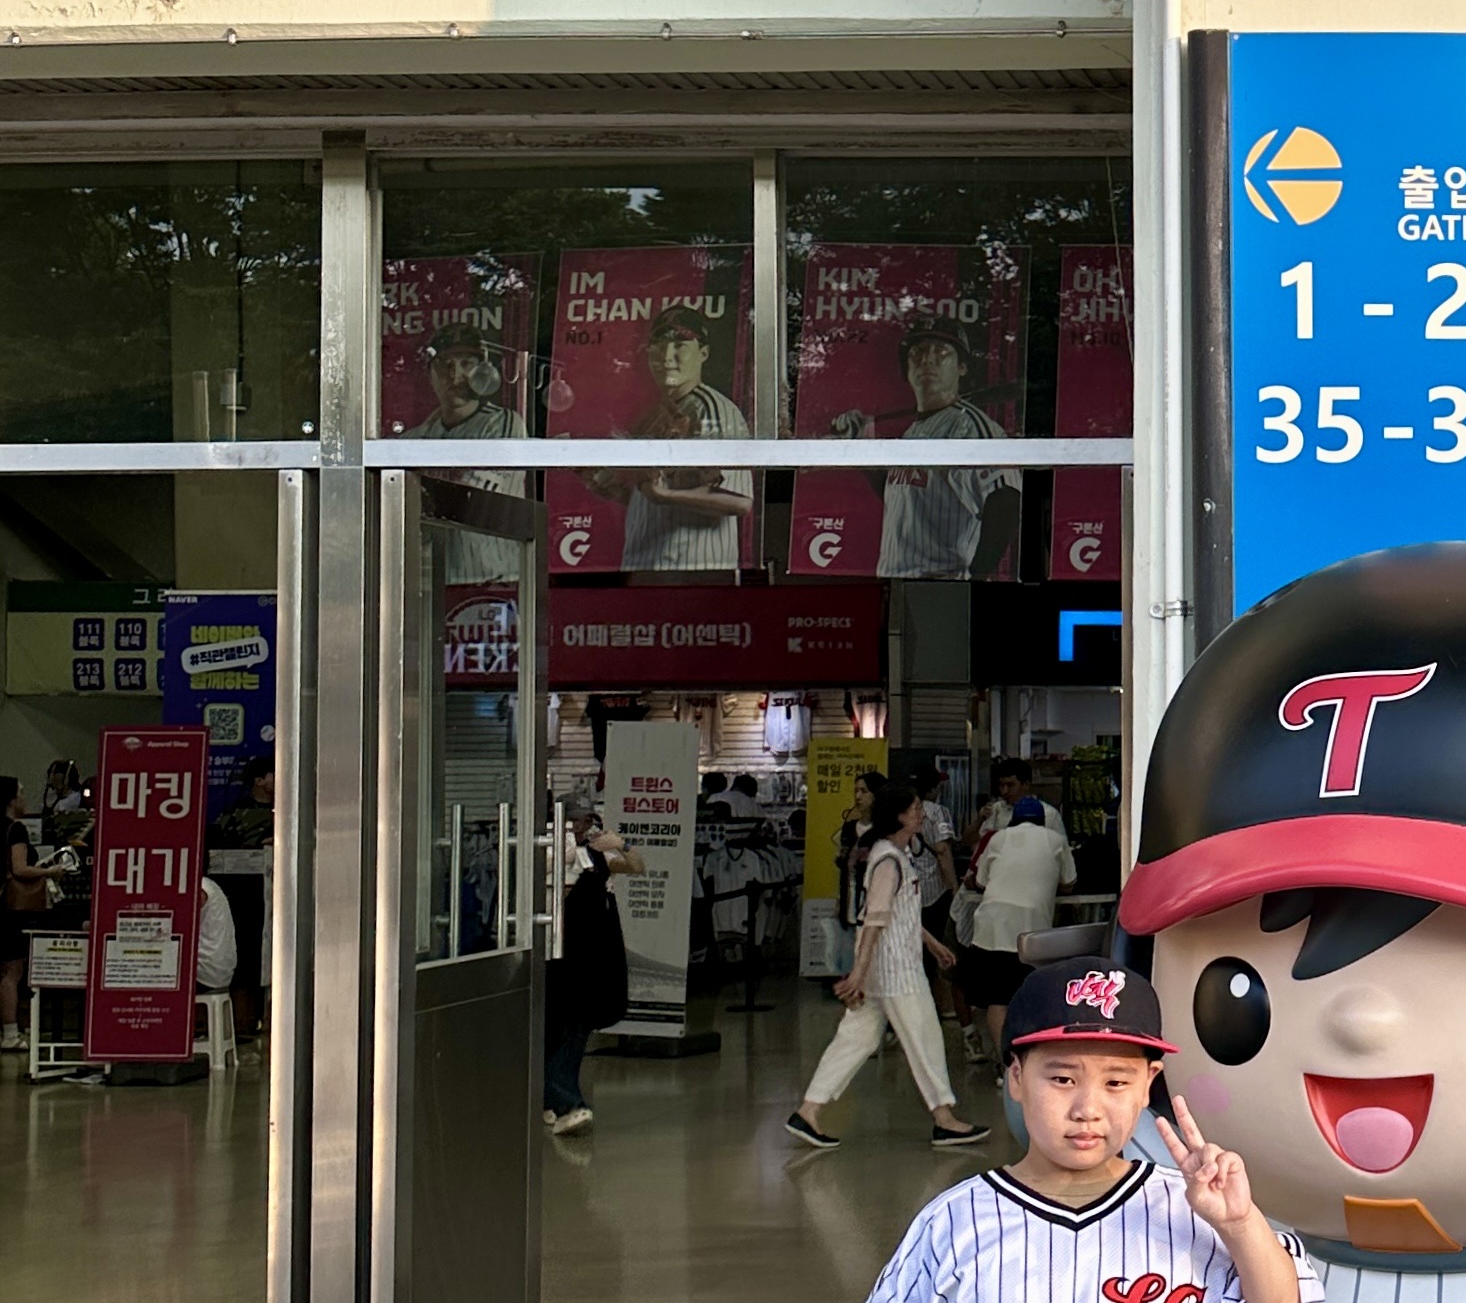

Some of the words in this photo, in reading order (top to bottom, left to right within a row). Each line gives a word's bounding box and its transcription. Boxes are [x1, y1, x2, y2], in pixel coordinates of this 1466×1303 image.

[569, 271, 606, 295] IM
[817, 267, 881, 291] KIM
[566, 297, 653, 323] CHAN
[815, 296, 905, 321] HYUN
[1280, 261, 1313, 339] 1
[78, 623, 101, 635] 111
[119, 623, 142, 635] 110
[76, 663, 101, 675] 213
[118, 663, 143, 676] 212
[1278, 662, 1437, 798] T
[109, 771, 193, 820] 마킹
[630, 777, 673, 793] 트윈스
[623, 797, 679, 814] 팀스토어
[106, 847, 189, 895] 대기
